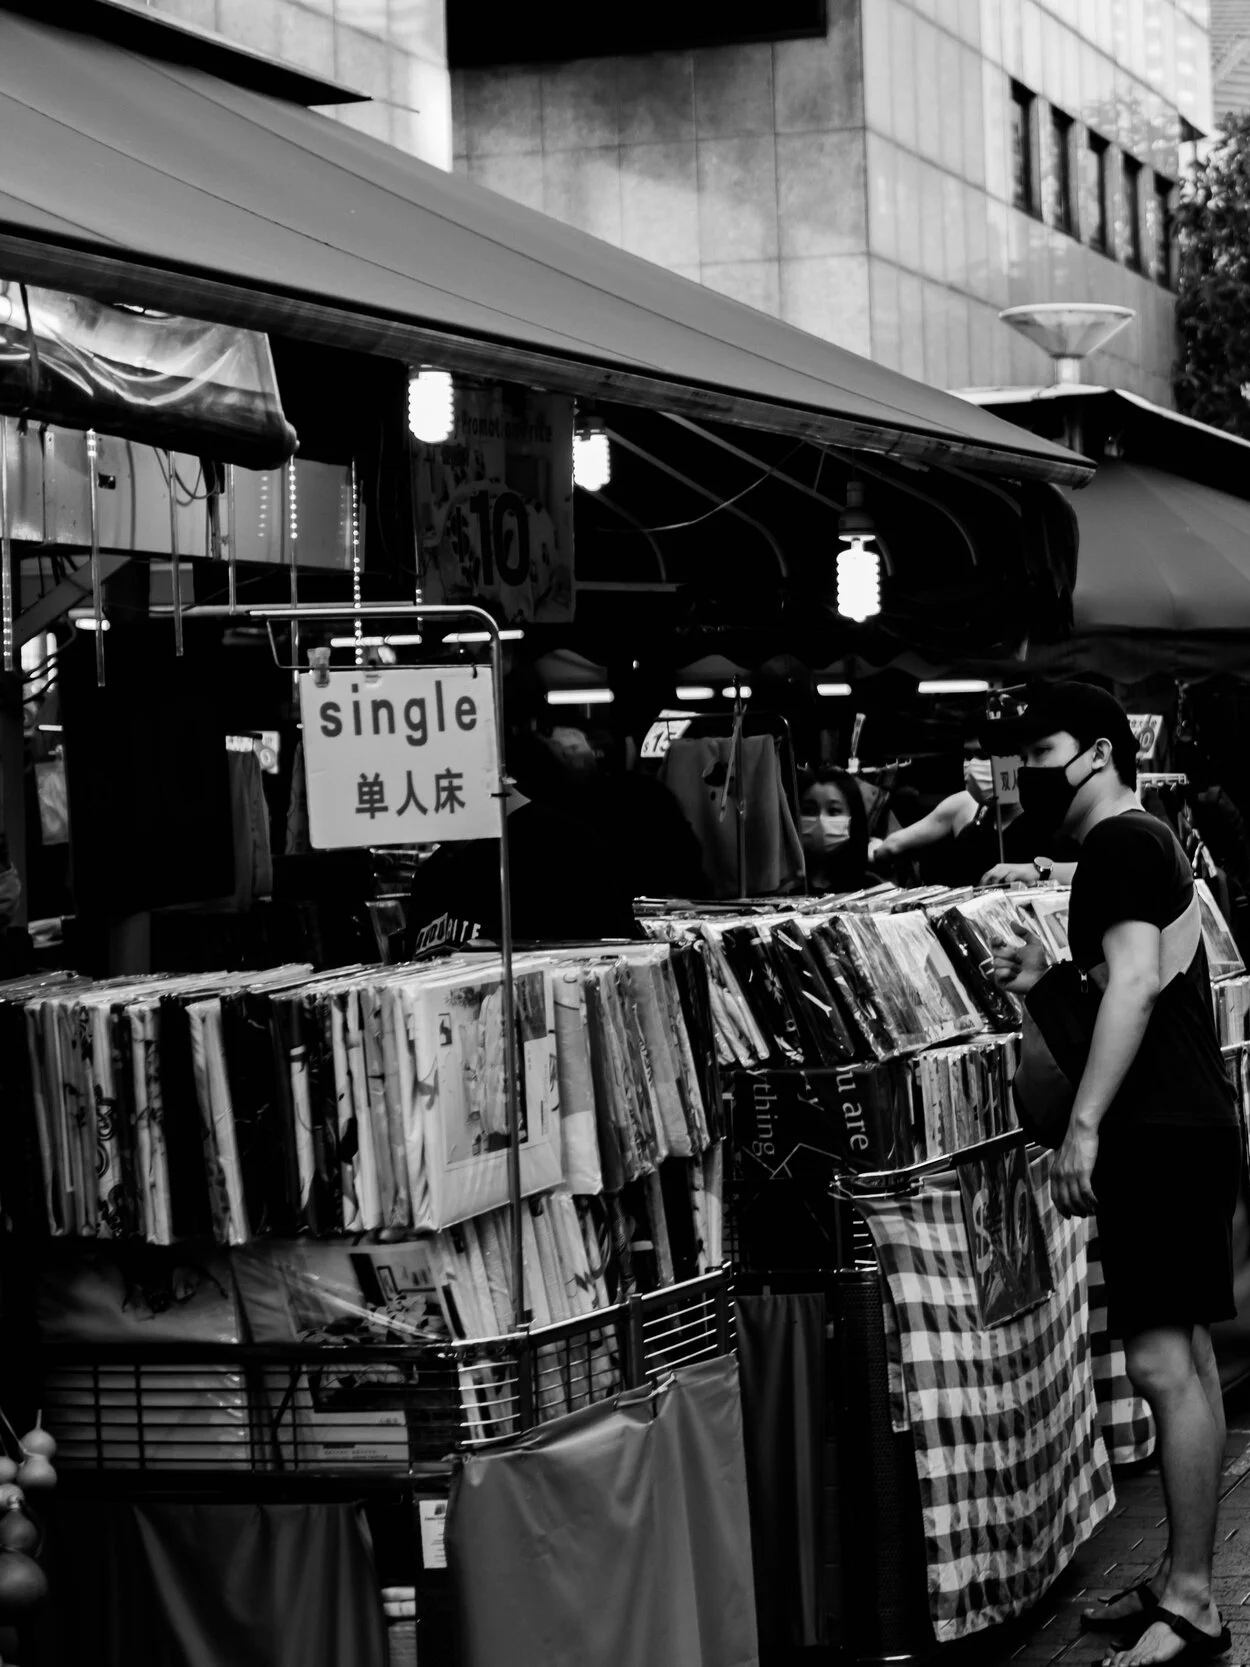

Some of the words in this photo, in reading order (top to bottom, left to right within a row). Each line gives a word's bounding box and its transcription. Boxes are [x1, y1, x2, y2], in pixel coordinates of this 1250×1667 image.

[318, 680, 477, 747] single
[355, 768, 466, 820] 单人床
[841, 1102, 869, 1151] are
